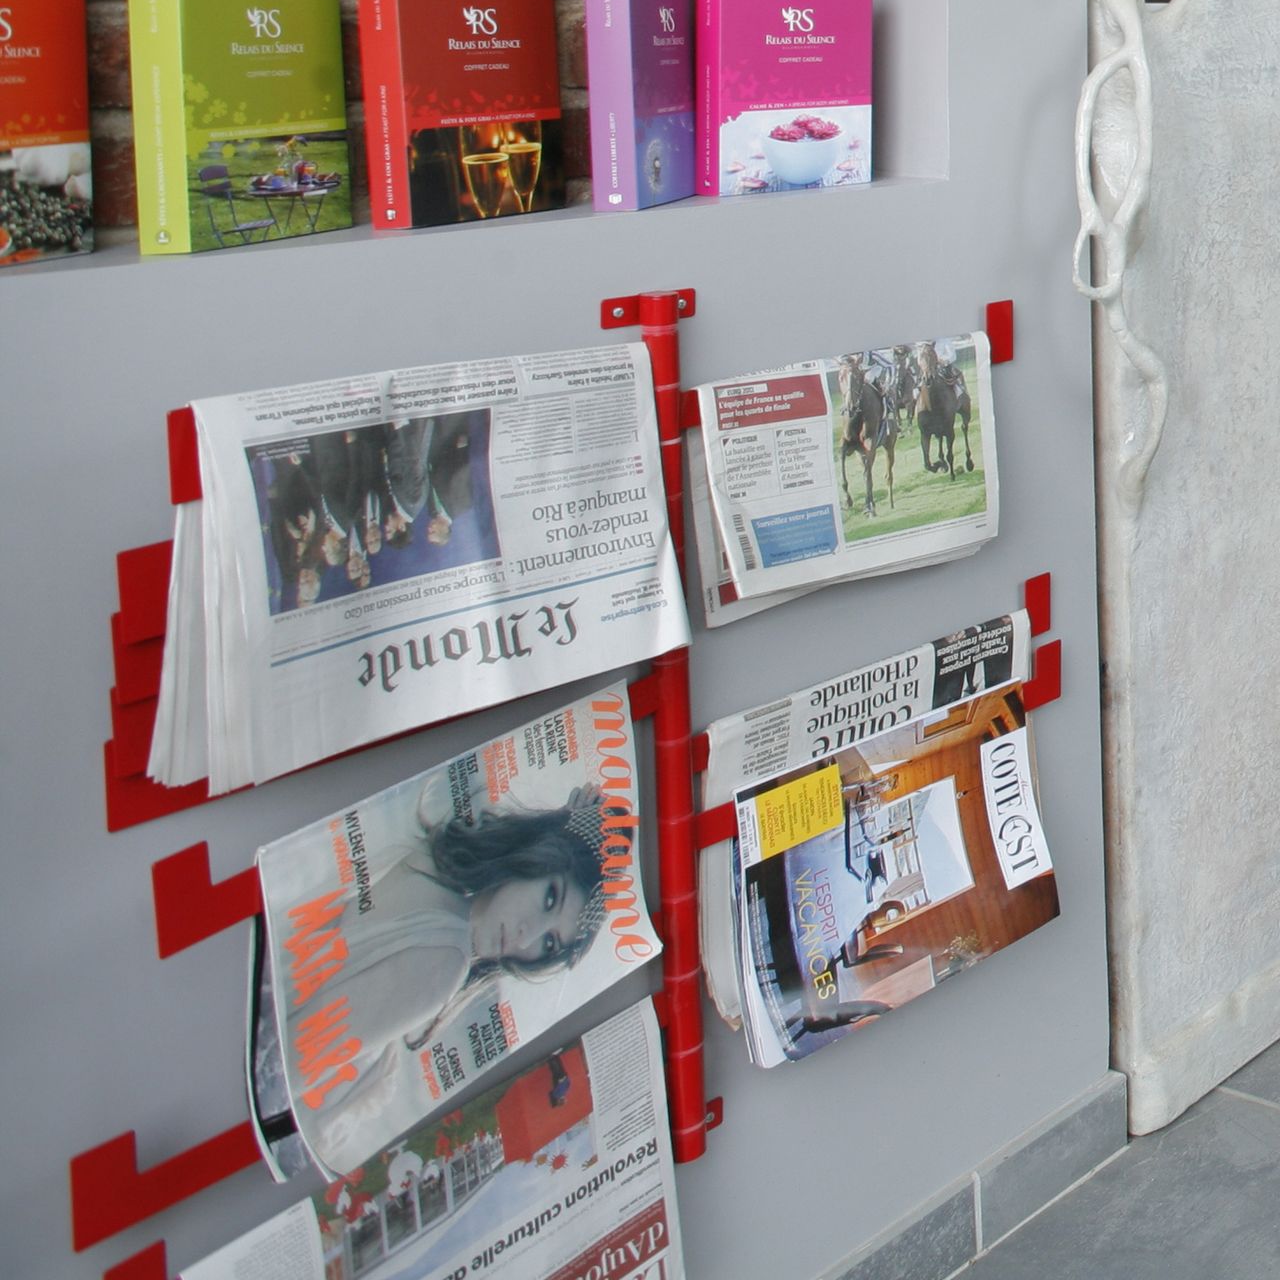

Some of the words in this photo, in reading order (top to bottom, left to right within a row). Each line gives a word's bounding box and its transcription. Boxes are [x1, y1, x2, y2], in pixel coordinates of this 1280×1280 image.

[231, 42, 260, 56] RELAIS
[261, 44, 273, 54] DU
[274, 40, 305, 55] SILENCE
[447, 37, 477, 51] RELAIS
[477, 39, 491, 50] DU
[491, 37, 522, 50] SILENCE
[765, 33, 793, 46] RELAIS
[793, 36, 807, 45] DU
[806, 33, 836, 45] SILENCE
[463, 63, 488, 72] COFFRET
[488, 63, 510, 71] CADEAU
[778, 56, 802, 64] COFFRET
[802, 55, 823, 63] CADEAU
[608, 112, 617, 133] LIBERTY
[611, 163, 619, 189] COFFRET
[531, 371, 563, 382] Sarkozy
[563, 369, 589, 379] années
[590, 367, 603, 376] des
[603, 363, 627, 375] procès
[627, 363, 635, 372] le
[440, 380, 480, 395] résultats
[481, 379, 497, 390] des
[497, 375, 516, 387] pour
[567, 377, 585, 387] faire
[458, 394, 465, 403] le
[467, 388, 497, 402] passer
[497, 386, 519, 398] Faire
[285, 399, 327, 417] espionne
[327, 399, 342, 411] qui
[342, 395, 374, 412] logiciel
[366, 405, 382, 416] Sur
[718, 399, 745, 410] L'équipe
[744, 397, 753, 406] de
[752, 395, 774, 405] France
[719, 411, 735, 421] pour
[735, 408, 744, 417] les
[744, 406, 764, 416] quarts
[764, 404, 773, 413] de
[773, 402, 792, 411] finale
[325, 411, 336, 421] de
[337, 407, 359, 420] piste
[567, 497, 577, 516] à
[578, 486, 647, 516] manqué
[532, 501, 563, 522] Rio
[545, 509, 649, 544] rendez-vous
[517, 531, 657, 574] Environnement
[453, 566, 506, 591] L'Europe
[381, 587, 422, 610] pression
[423, 582, 451, 598] sous
[343, 603, 368, 620] G20
[369, 601, 382, 612] au
[534, 596, 580, 646] Le
[978, 623, 1013, 642] sociétés
[357, 609, 533, 693] Monde
[936, 634, 978, 657] françaises
[959, 643, 980, 660] fiscal
[972, 644, 1009, 663] Cameron
[980, 636, 1007, 651] l'asile
[939, 656, 972, 676] propose
[942, 653, 959, 665] aux
[809, 654, 919, 708] d'Hollande
[902, 678, 920, 700] la
[806, 681, 897, 734] politique
[532, 723, 543, 738] des
[543, 717, 552, 731] LA
[553, 712, 565, 738] LADY
[523, 727, 536, 768] carapaces
[545, 730, 558, 756] REINE
[558, 738, 569, 766] GAGA
[466, 751, 480, 776] TEST
[503, 735, 520, 779] TENDANCE
[534, 737, 546, 770] femmes
[345, 809, 365, 858] MYLÈNE
[591, 691, 654, 963] madame
[351, 855, 376, 916] JAMPANOÏ
[813, 867, 840, 943] L'ESPRIT
[794, 867, 837, 1000] VACANCES
[282, 887, 350, 1007] MATA
[488, 1002, 504, 1034] DOLCE
[500, 1000, 520, 1048] LIFESTYLE
[480, 1023, 493, 1043] AUX
[293, 995, 363, 1111] HARI
[431, 1041, 444, 1058] DE
[467, 1022, 487, 1069] PONTINES
[495, 1033, 509, 1055] VITA
[436, 1055, 455, 1092] CUISINE
[446, 1046, 466, 1083] CARNET
[565, 1137, 660, 1209] Révolution
[470, 1203, 562, 1272] culturelle
